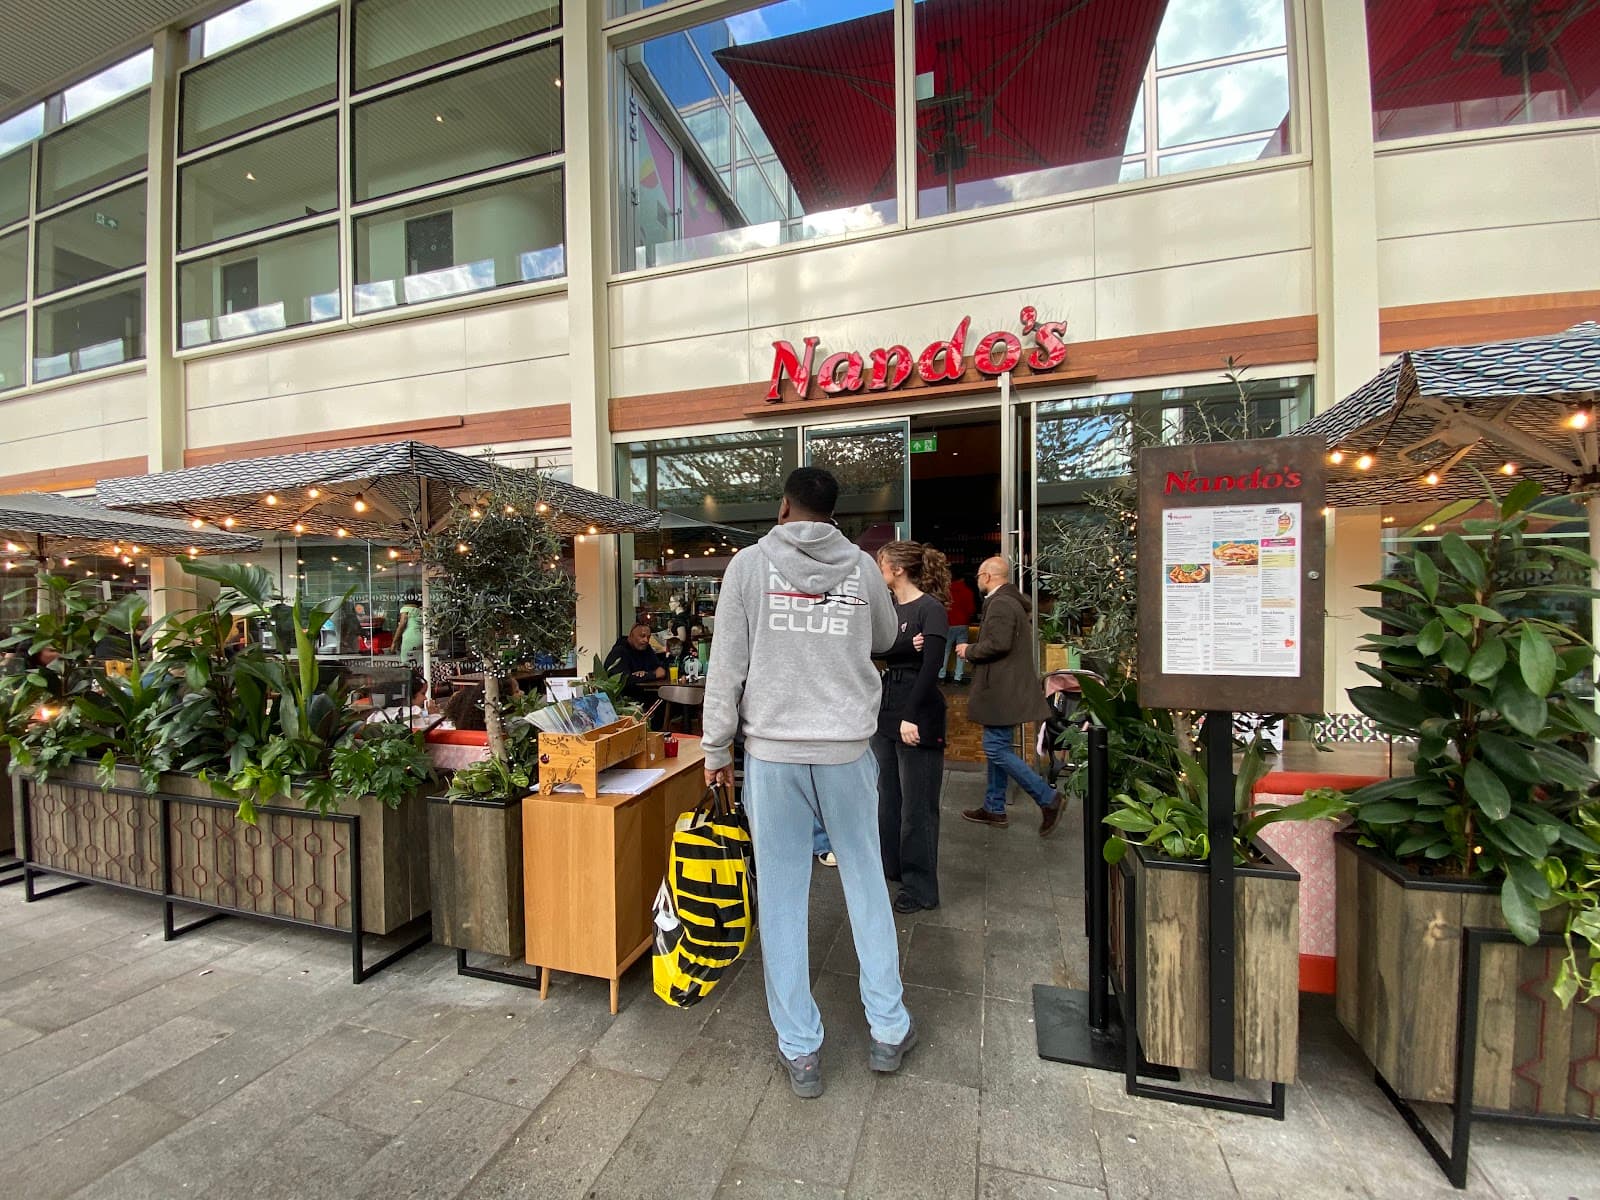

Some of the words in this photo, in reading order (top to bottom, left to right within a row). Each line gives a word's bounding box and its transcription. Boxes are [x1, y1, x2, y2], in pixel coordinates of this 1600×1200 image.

[765, 305, 1067, 403] Nando's
[1163, 464, 1302, 496] Nando's
[768, 612, 849, 636] CLUB
